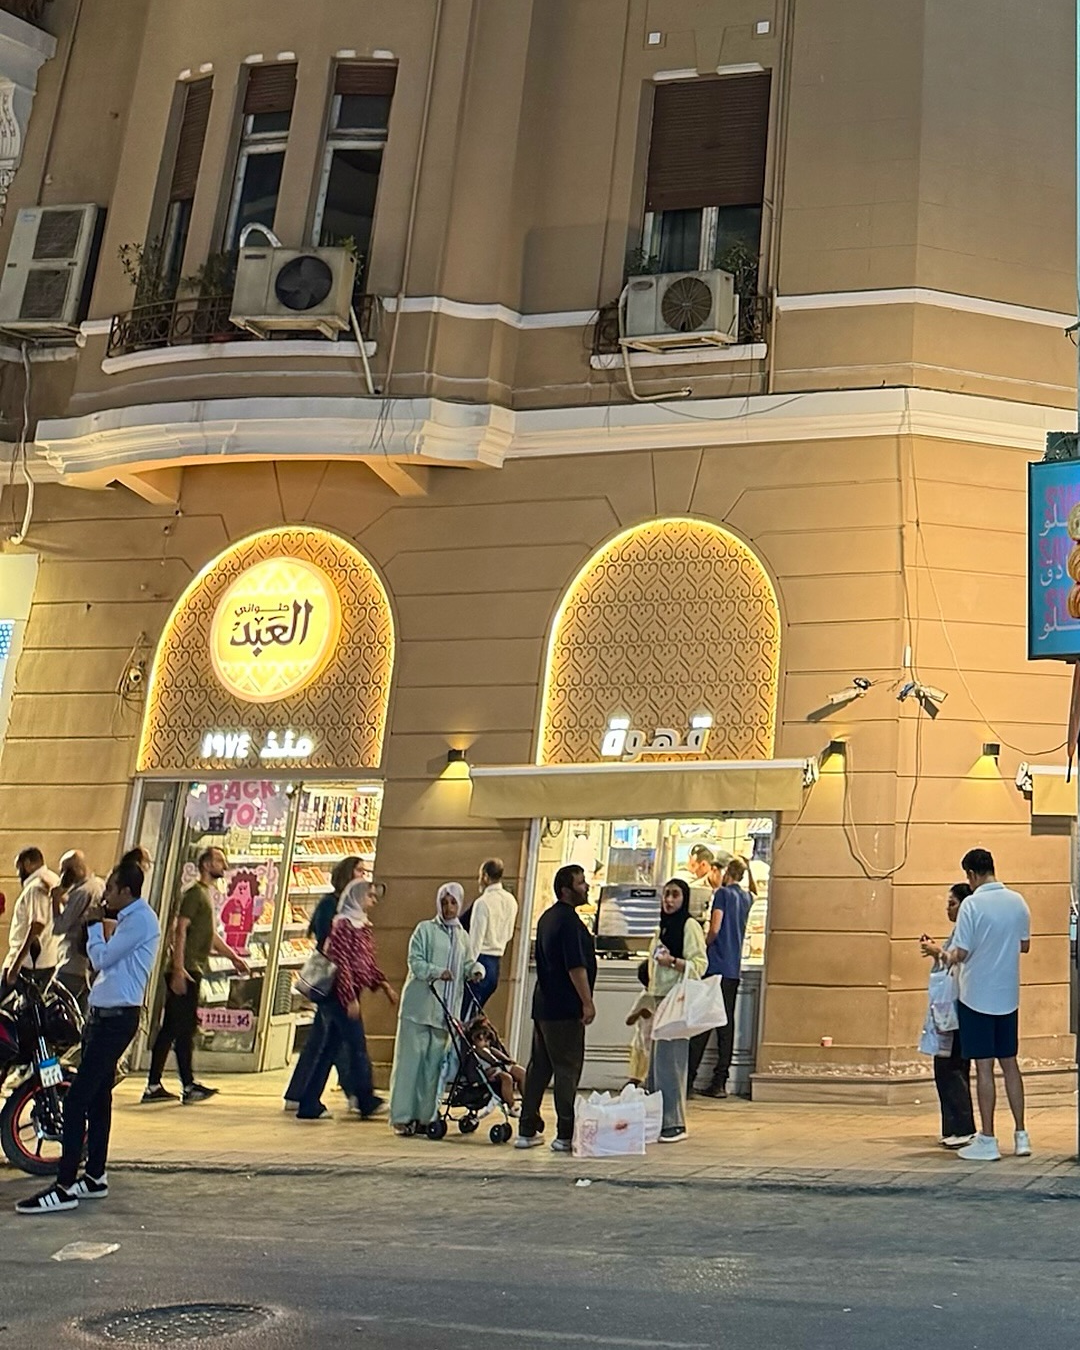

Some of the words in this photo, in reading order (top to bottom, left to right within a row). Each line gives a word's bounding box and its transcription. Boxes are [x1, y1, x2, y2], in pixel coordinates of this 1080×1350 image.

[260, 730, 315, 758] منذ
[601, 716, 713, 762] قهوة
[208, 781, 275, 805] BACK
[206, 1013, 231, 1024] 17111
